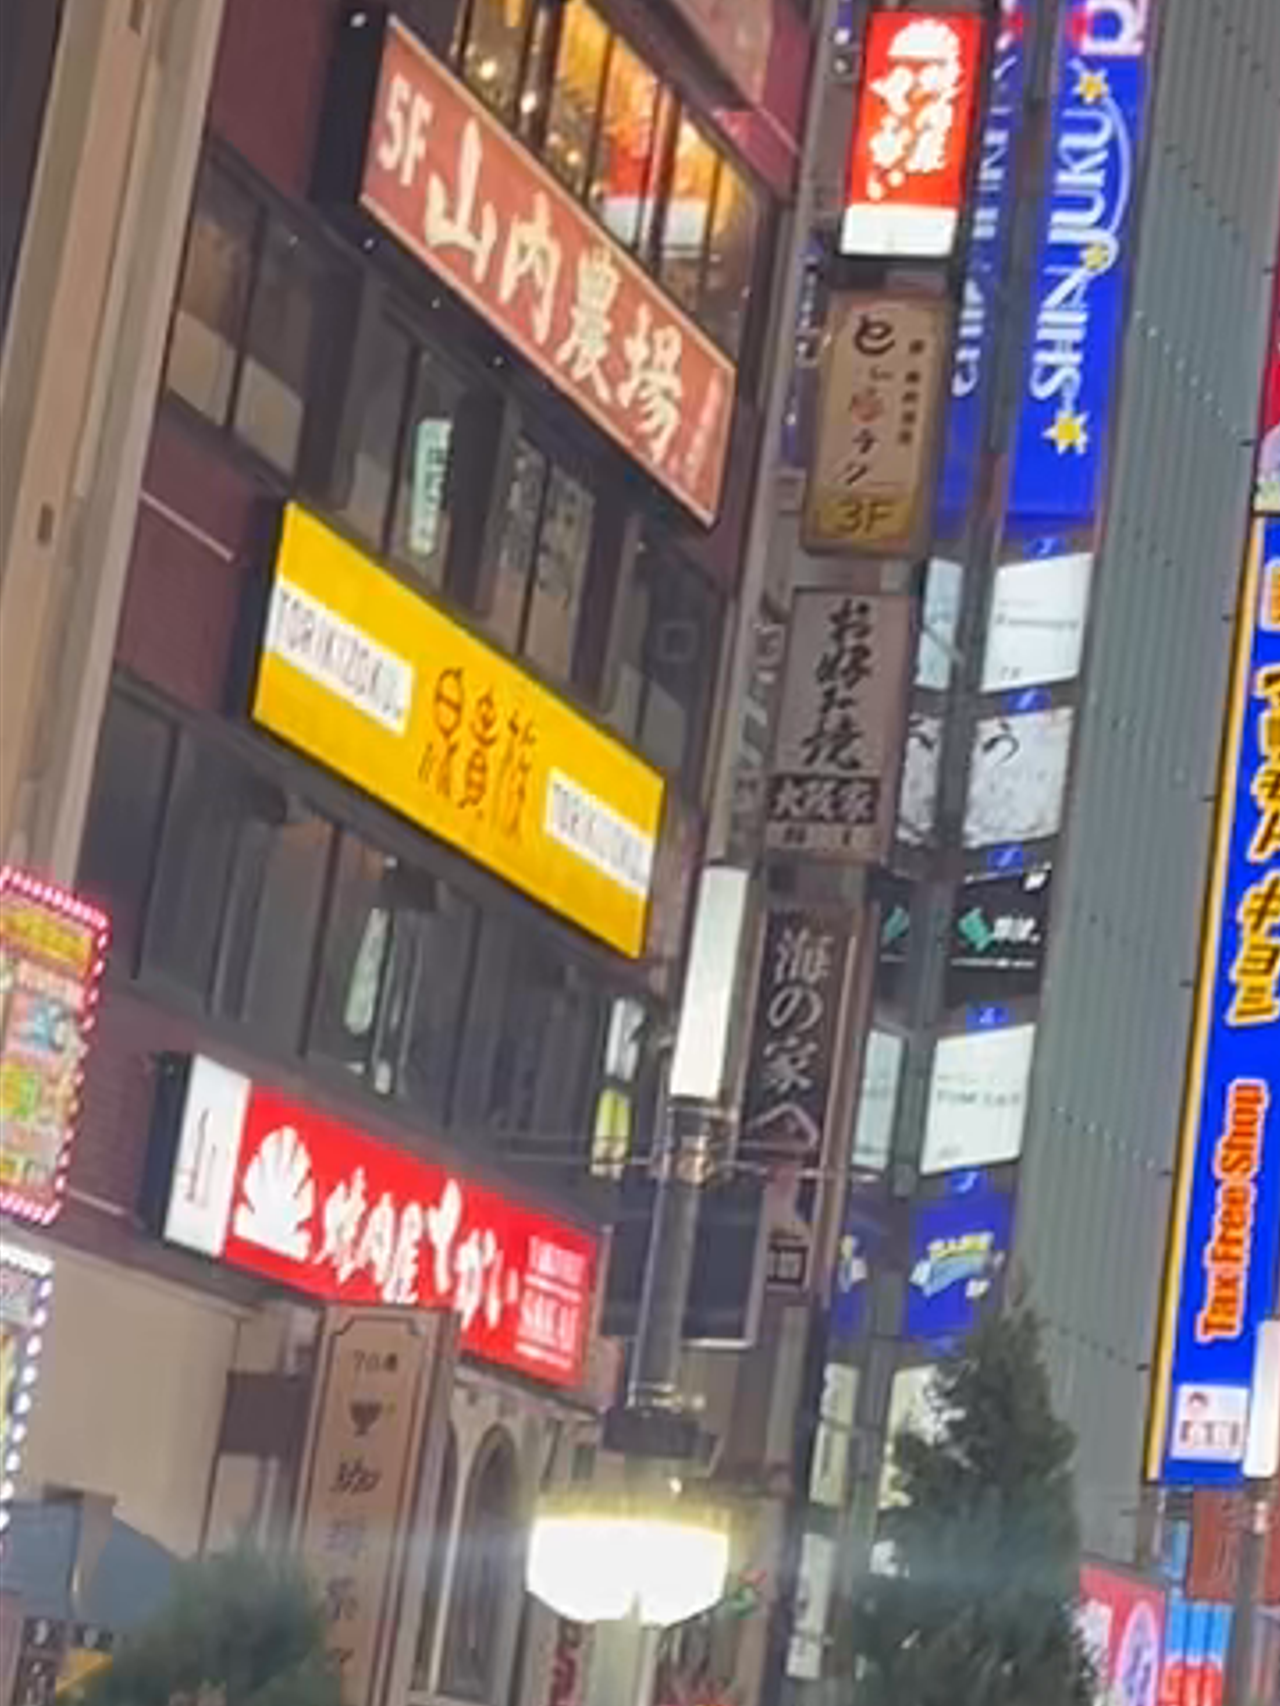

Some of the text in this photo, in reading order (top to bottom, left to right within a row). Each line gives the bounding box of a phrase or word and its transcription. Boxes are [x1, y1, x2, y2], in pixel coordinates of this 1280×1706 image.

[423, 118, 690, 470] 山内農場
[1029, 99, 1115, 401] SHINJUKU
